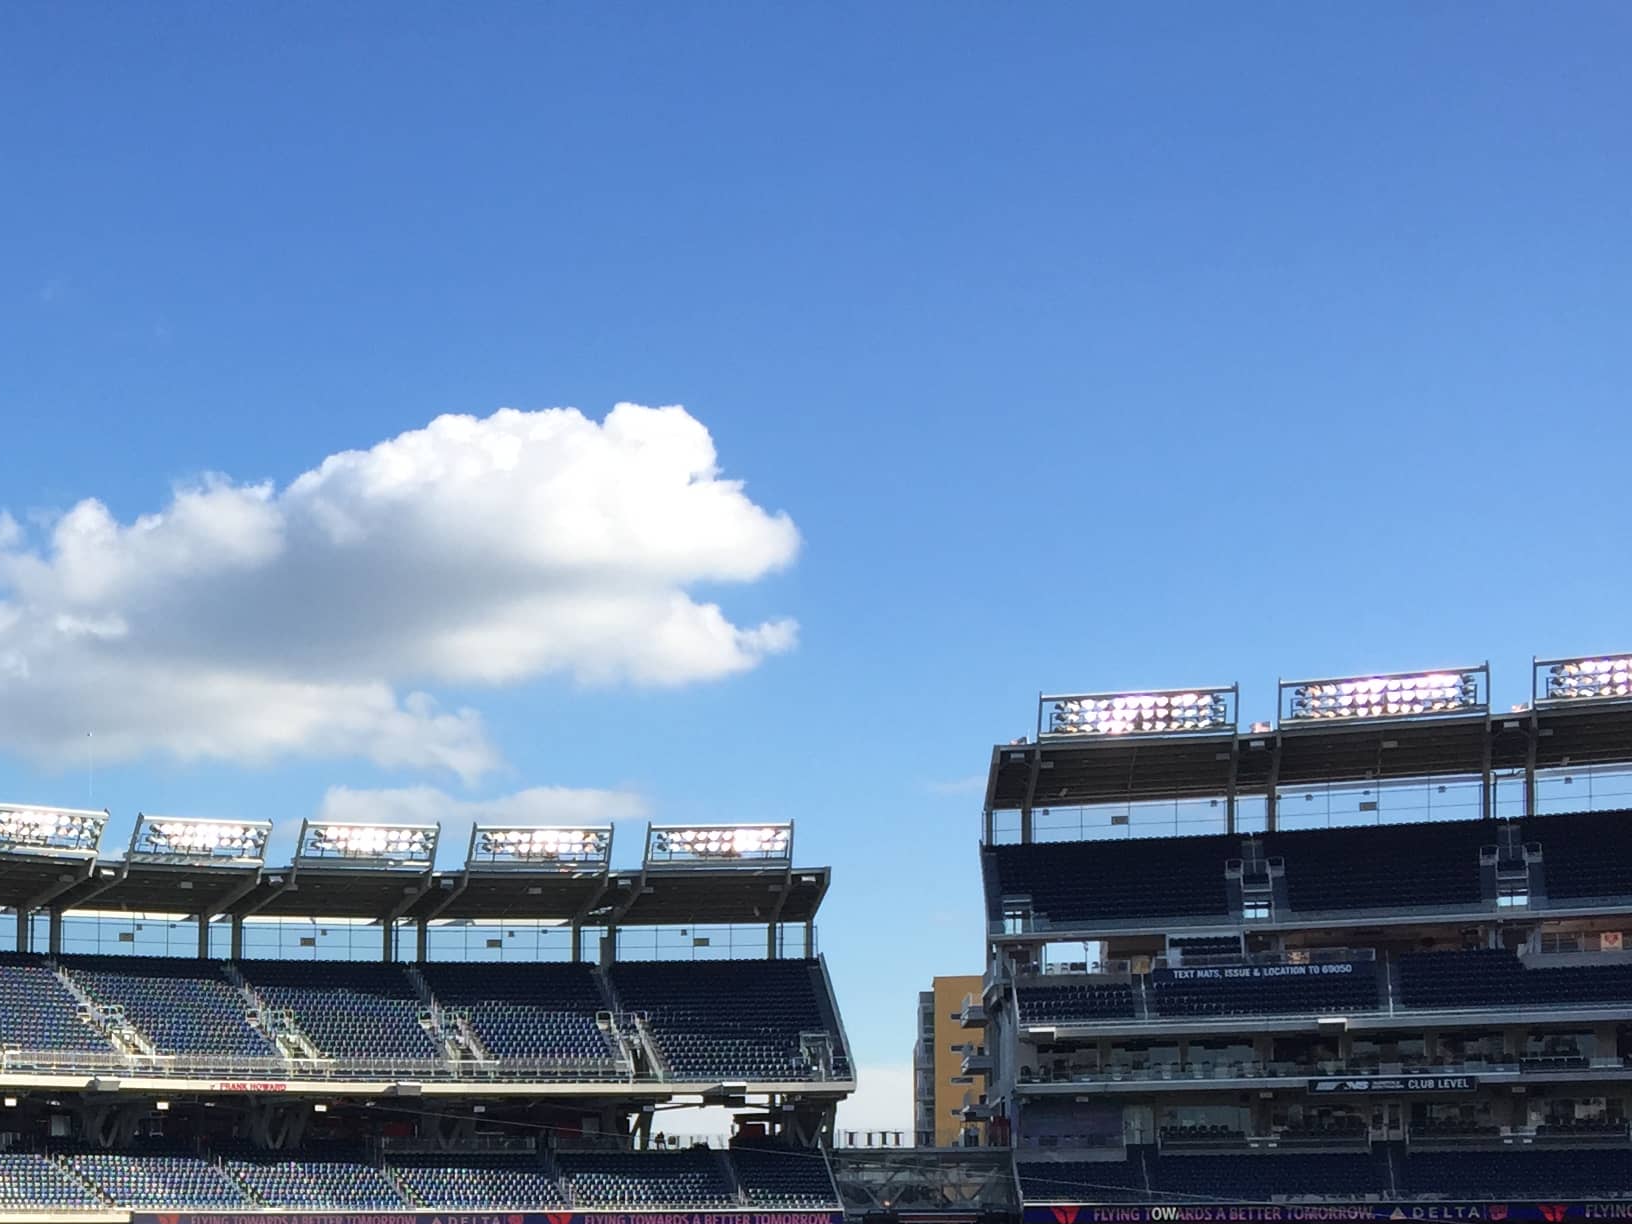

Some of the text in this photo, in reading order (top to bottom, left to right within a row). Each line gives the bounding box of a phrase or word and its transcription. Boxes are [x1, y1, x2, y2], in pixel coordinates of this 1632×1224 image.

[1173, 969, 1195, 979] TEXT
[1225, 967, 1251, 978] ISSUE
[1264, 966, 1306, 977] LOCATION
[1308, 965, 1319, 975] TO
[1408, 1079, 1434, 1089] CLUB
[1438, 1078, 1469, 1089] LEVEL
[1094, 1207, 1140, 1222] FLYING
[1146, 1206, 1213, 1222] TOWARDS
[1215, 1207, 1227, 1221] A
[1230, 1206, 1282, 1221] BETTER
[1412, 1206, 1481, 1219] DELTA
